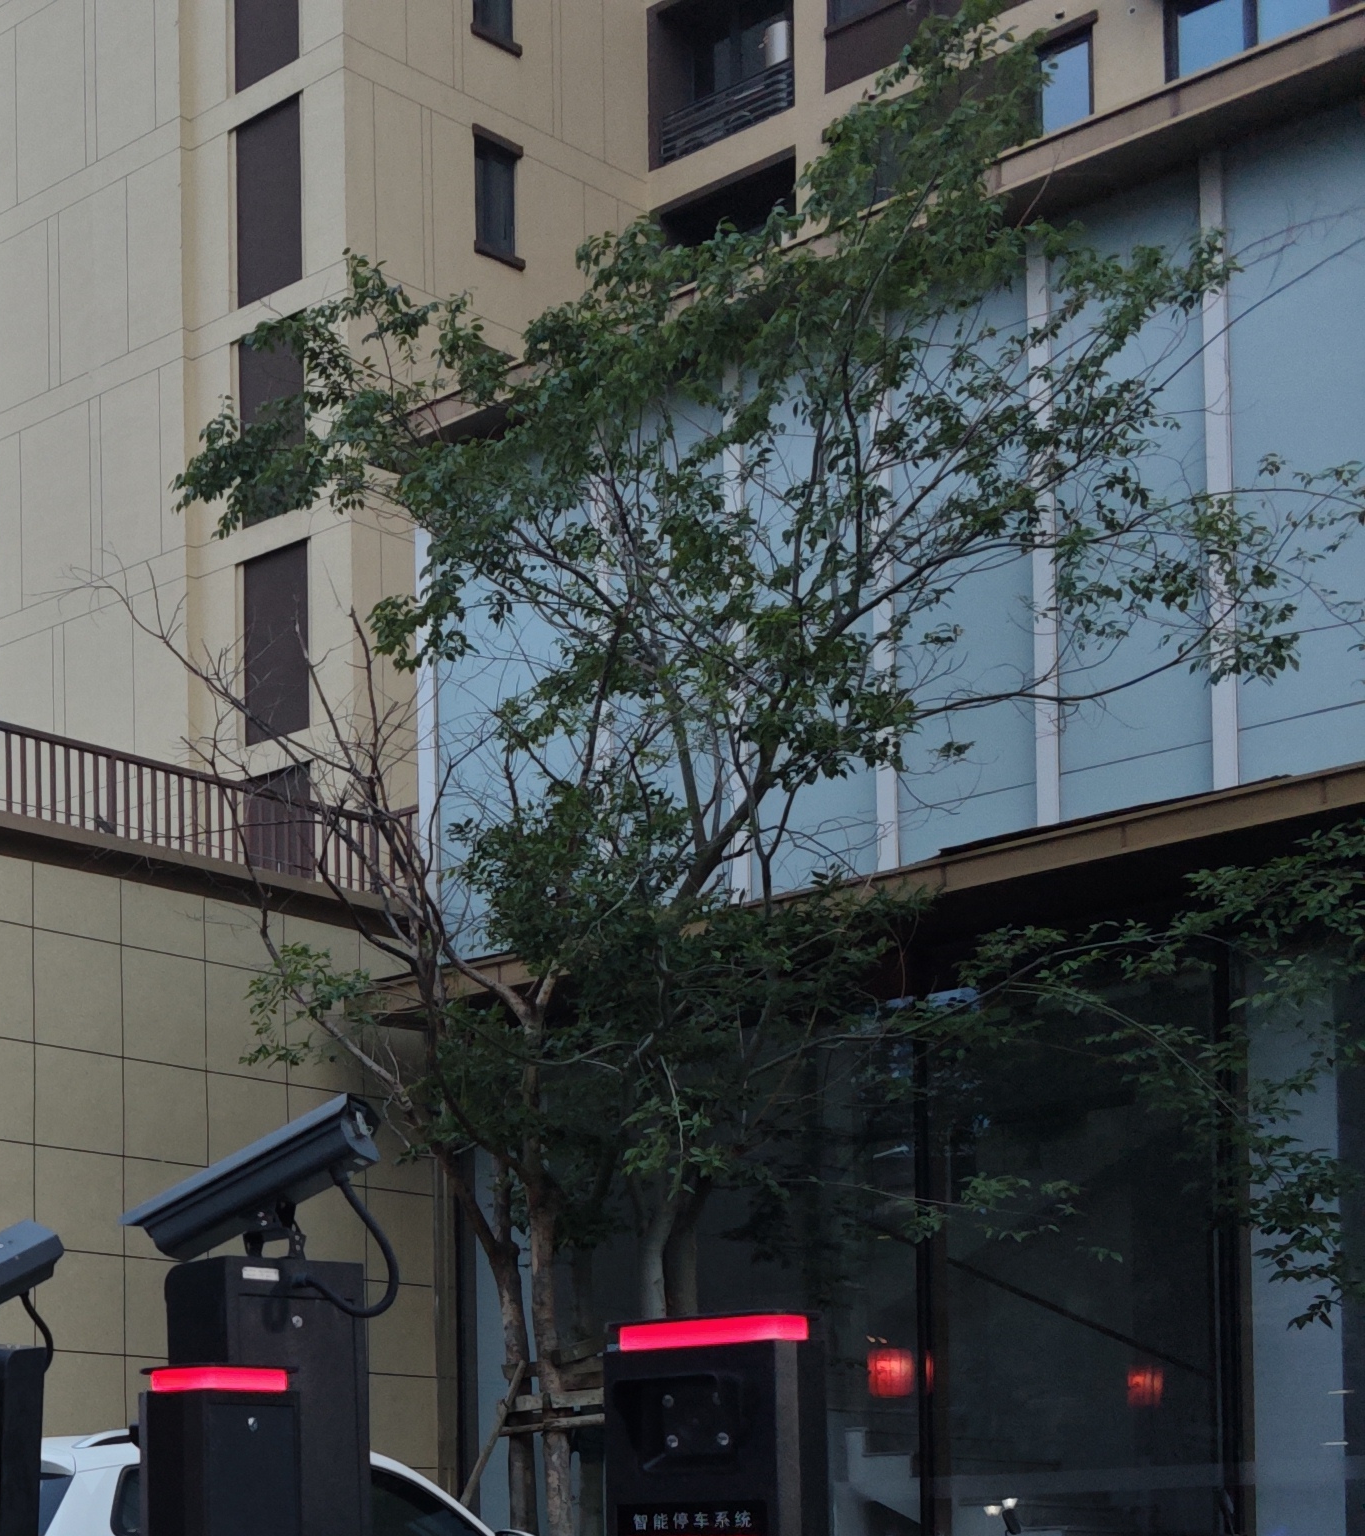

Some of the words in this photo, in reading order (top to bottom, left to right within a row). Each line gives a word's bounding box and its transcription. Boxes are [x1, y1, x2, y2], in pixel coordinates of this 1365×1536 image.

[633, 1510, 752, 1530] 智能停车系统
